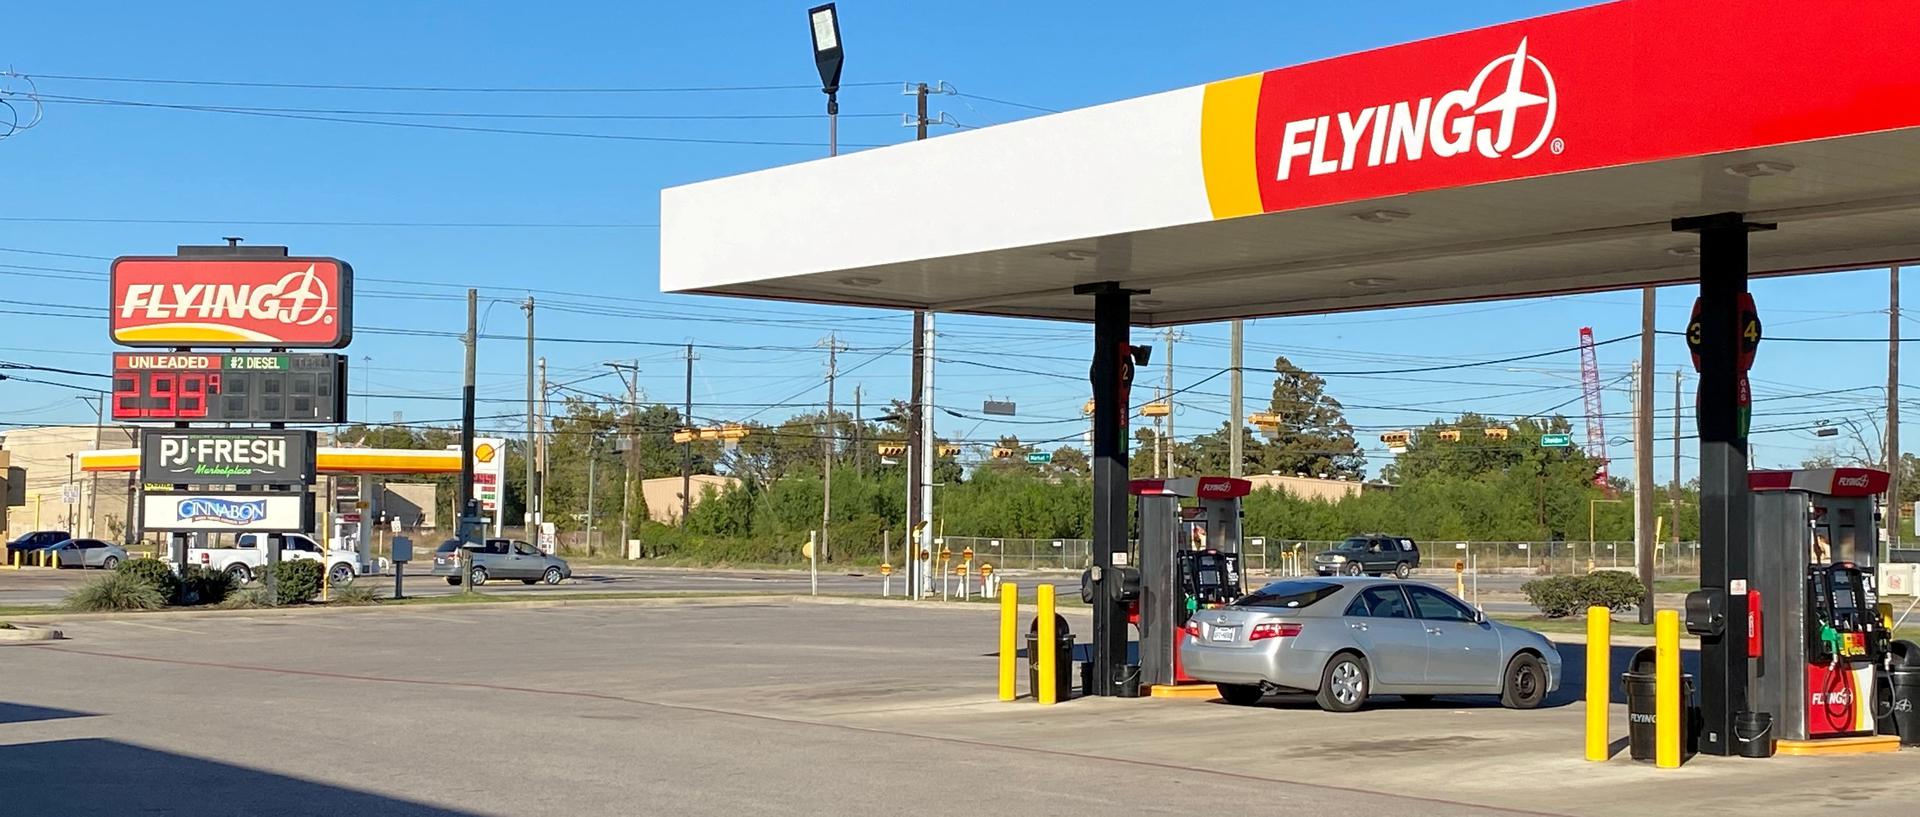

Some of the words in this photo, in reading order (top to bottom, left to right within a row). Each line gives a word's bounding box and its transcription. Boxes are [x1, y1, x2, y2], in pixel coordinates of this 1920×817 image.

[1744, 320, 1758, 342] 4
[129, 356, 208, 369] UNLEADED
[230, 357, 244, 369] #2
[246, 357, 280, 369] DIESEL
[1122, 363, 1129, 380] 2
[179, 500, 265, 520] CINNABON
